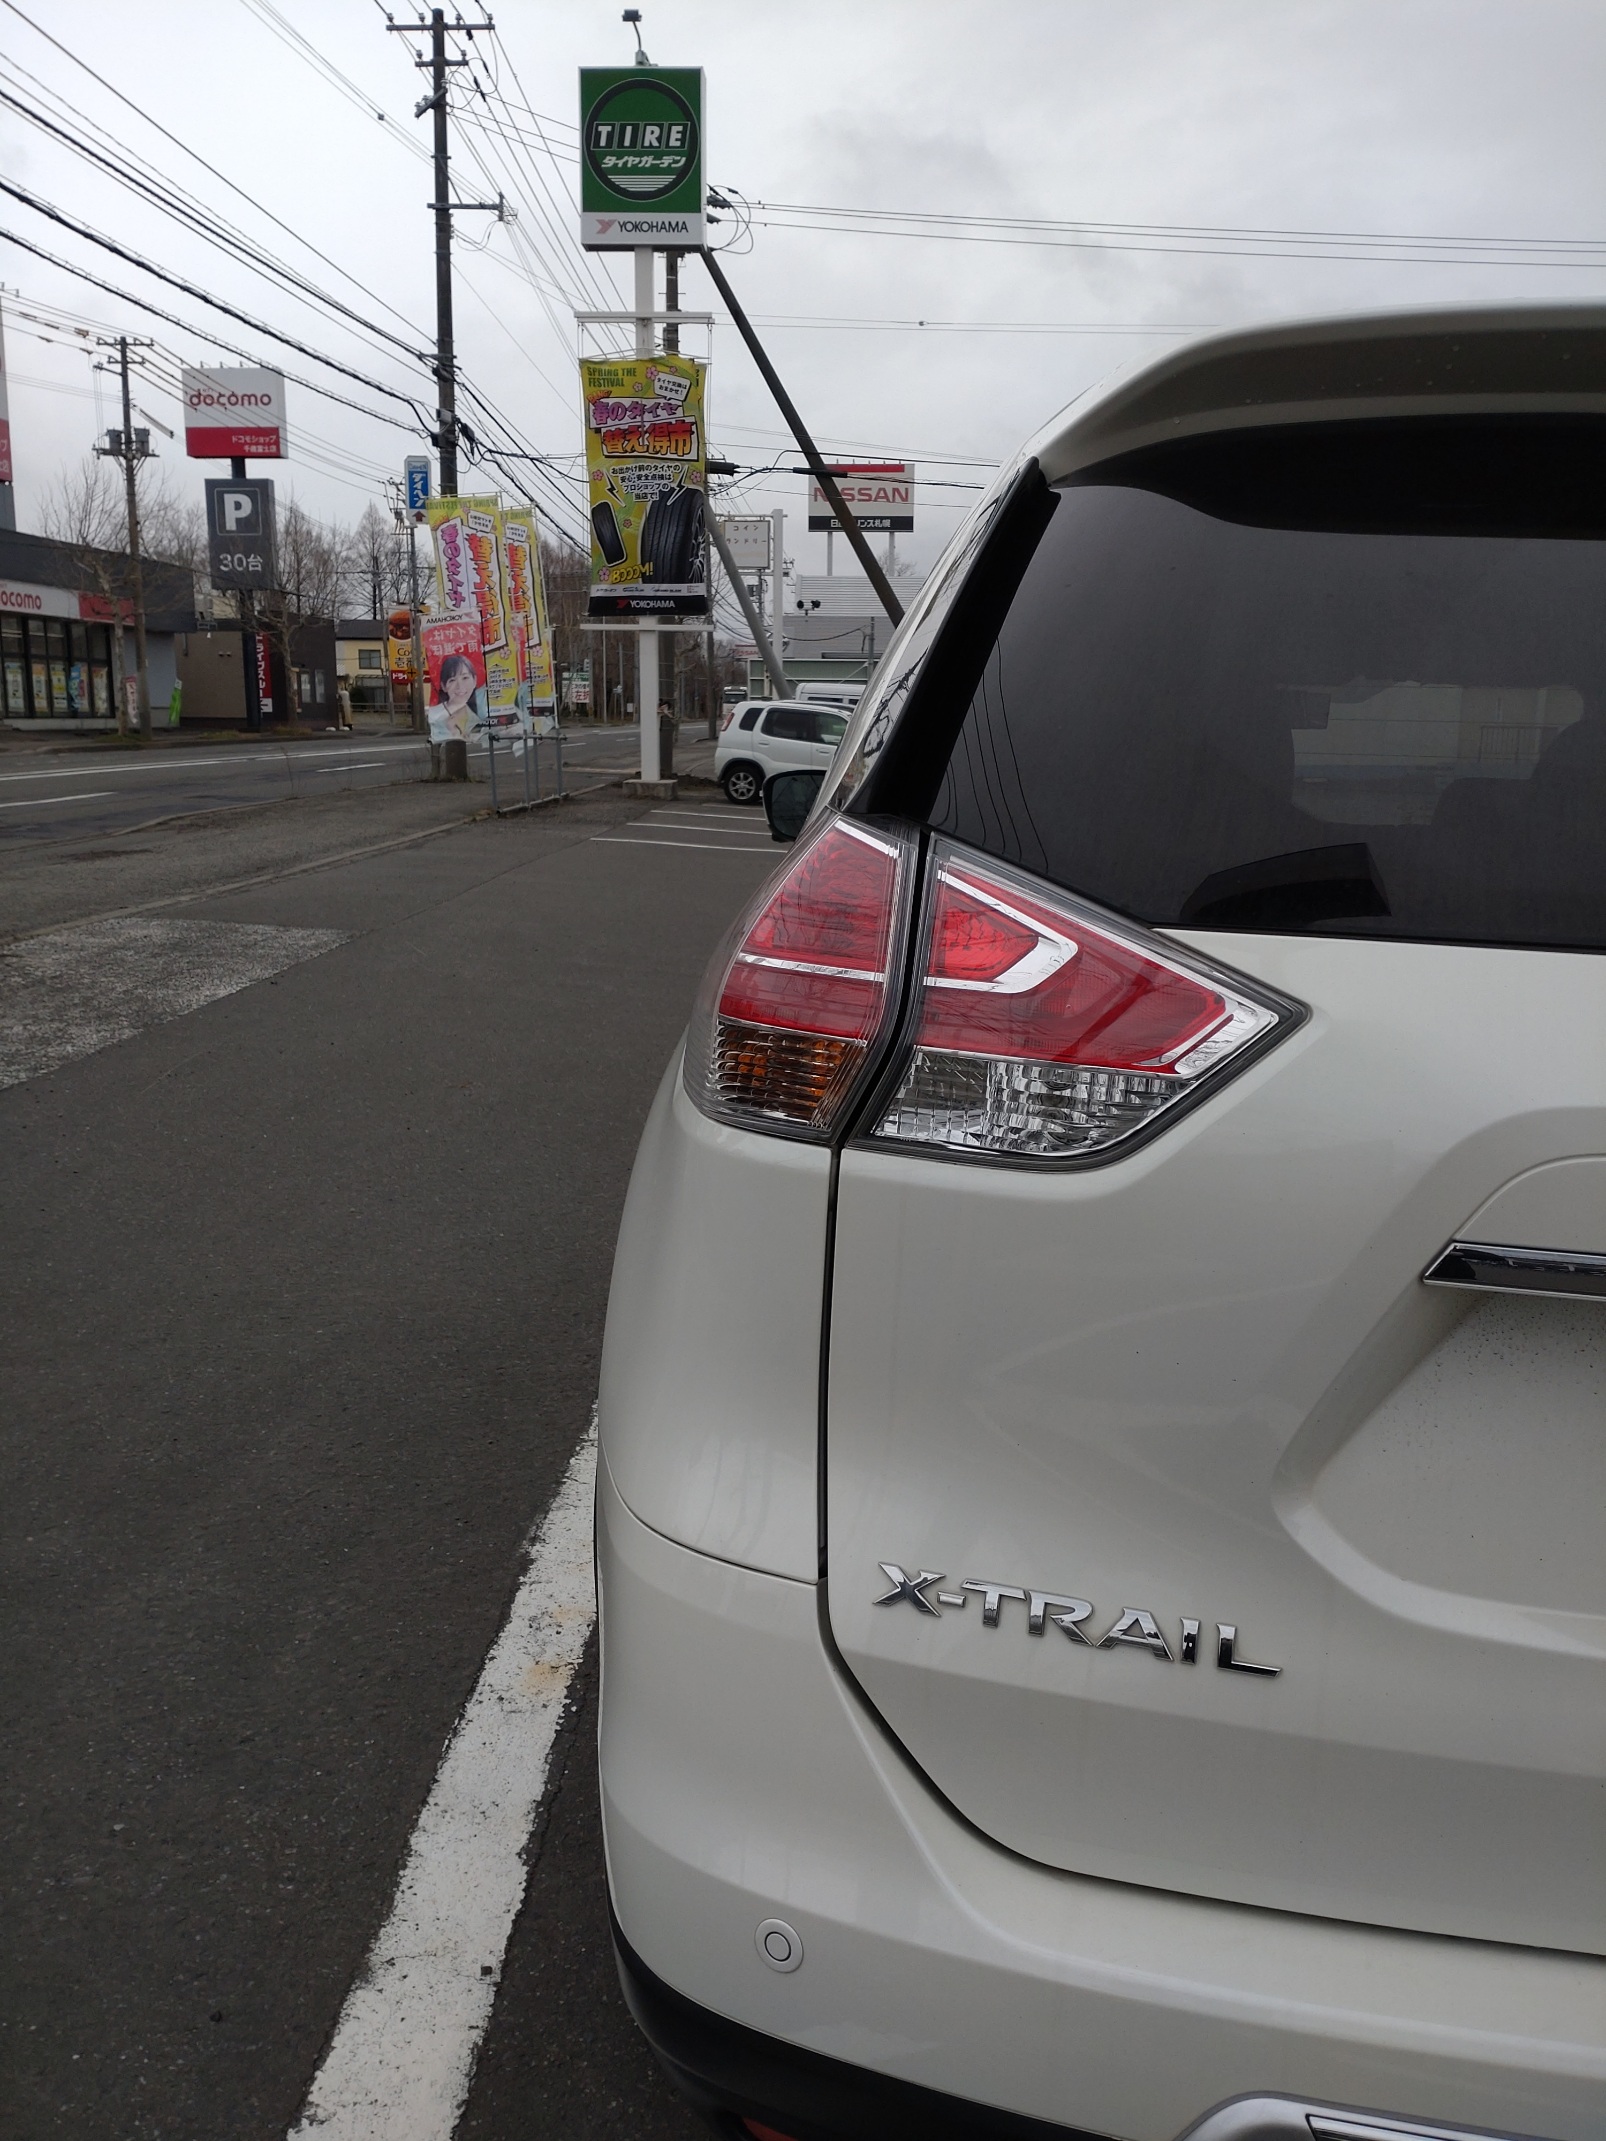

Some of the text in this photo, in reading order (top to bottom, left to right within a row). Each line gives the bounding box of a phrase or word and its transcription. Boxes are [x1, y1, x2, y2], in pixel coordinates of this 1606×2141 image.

[597, 125, 683, 147] TIRE
[601, 155, 687, 168] タイヤガーデン
[617, 220, 689, 233] YOKOHAMA
[586, 366, 637, 377] SPRING THE
[588, 377, 625, 388] FESTIVAL
[189, 389, 272, 407] docomo
[593, 401, 680, 425] 春のタイヤ
[231, 435, 277, 444] ドコモショップ
[602, 419, 695, 457] 替え得市
[813, 487, 909, 503] NSSAN
[223, 493, 252, 531] P
[219, 553, 263, 572] 30台
[0, 590, 42, 611] ocomo
[629, 600, 676, 609] YOKOHAMA
[872, 1561, 1283, 1679] X-TRAIL
